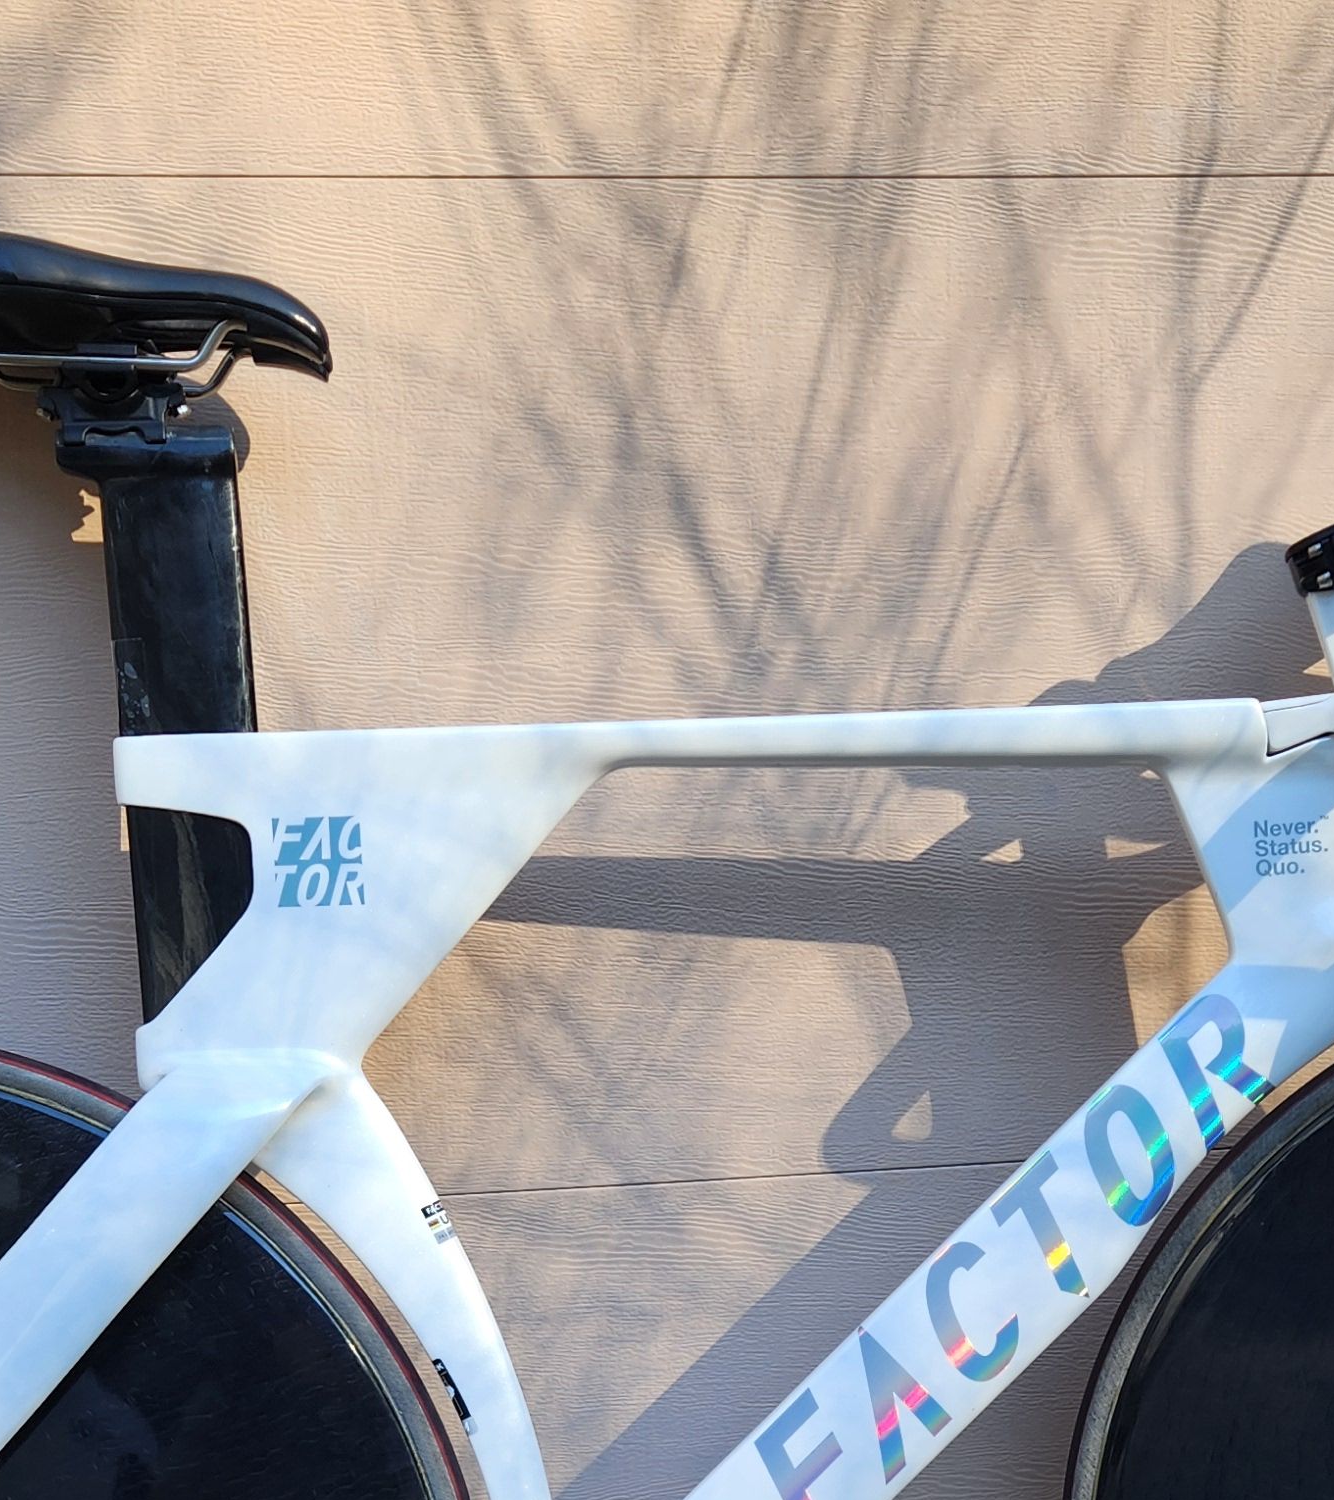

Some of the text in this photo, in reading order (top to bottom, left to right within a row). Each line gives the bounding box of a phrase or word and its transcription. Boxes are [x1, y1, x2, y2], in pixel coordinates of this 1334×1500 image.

[271, 816, 363, 862] FAC
[1255, 837, 1329, 857] Status.
[1256, 858, 1306, 877] Quo.
[273, 863, 366, 908] TOR
